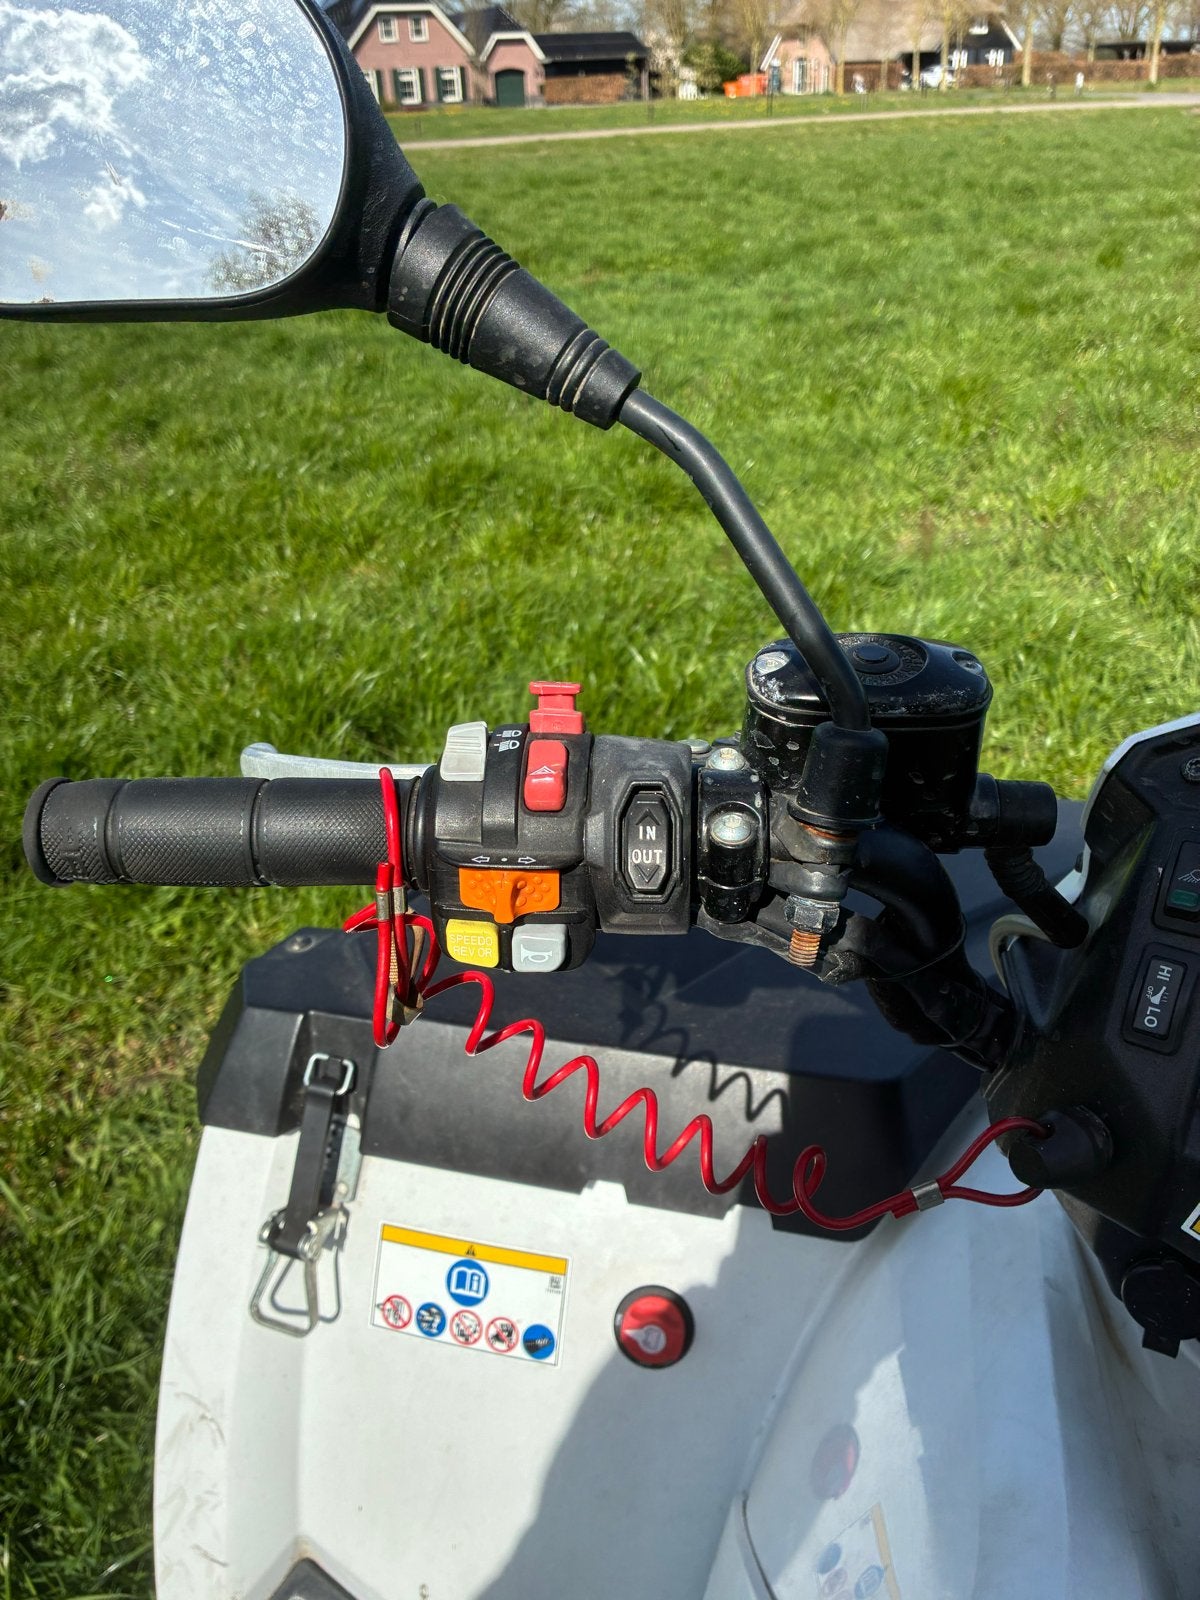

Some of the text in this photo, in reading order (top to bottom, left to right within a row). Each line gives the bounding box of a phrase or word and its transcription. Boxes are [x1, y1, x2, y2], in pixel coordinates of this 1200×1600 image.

[638, 825, 657, 841] IN
[631, 848, 663, 865] OUT
[449, 933, 493, 946] SPEEDO
[1156, 964, 1173, 982] HI
[1145, 985, 1154, 999] OFF
[1143, 1006, 1161, 1028] LO
